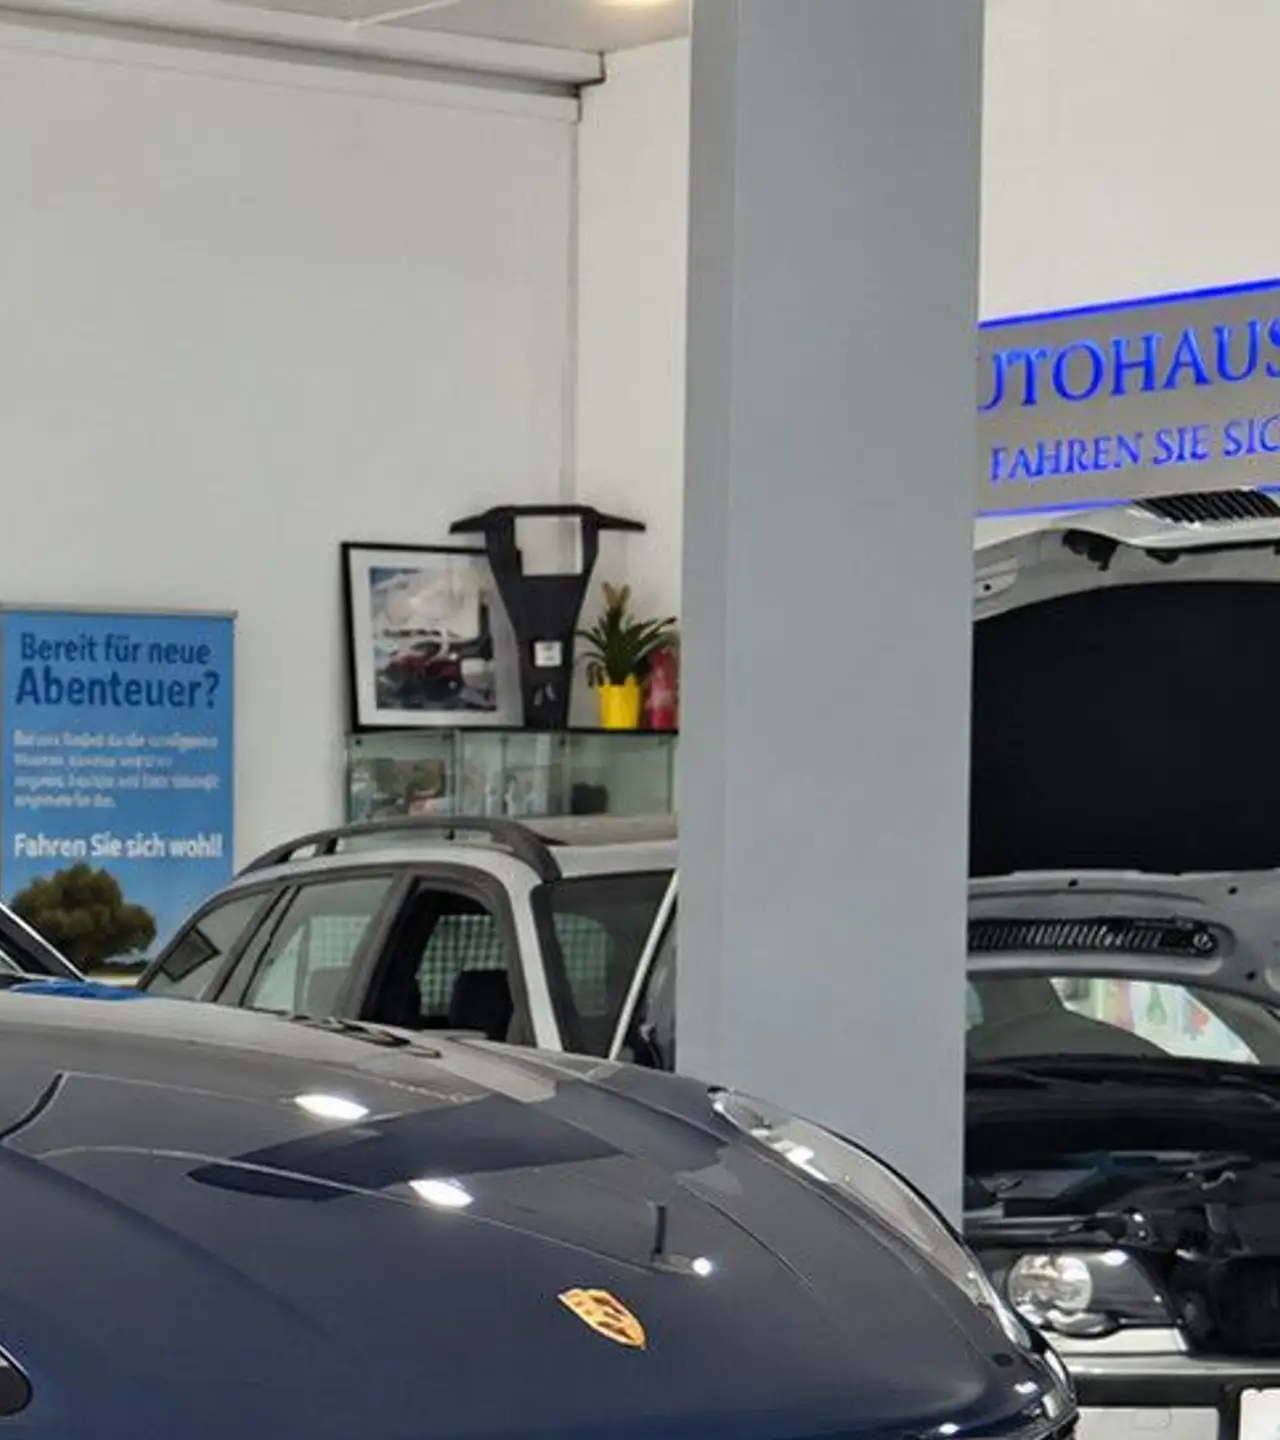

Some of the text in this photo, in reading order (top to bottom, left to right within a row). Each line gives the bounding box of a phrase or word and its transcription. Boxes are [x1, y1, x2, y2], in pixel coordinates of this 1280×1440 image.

[989, 430, 1145, 482] FAHREN
[1152, 423, 1211, 465] SIE
[20, 632, 212, 665] Bereit für neue
[15, 665, 221, 709] Abenteuer?
[14, 830, 224, 859] Fahren Sie sich wohl!
